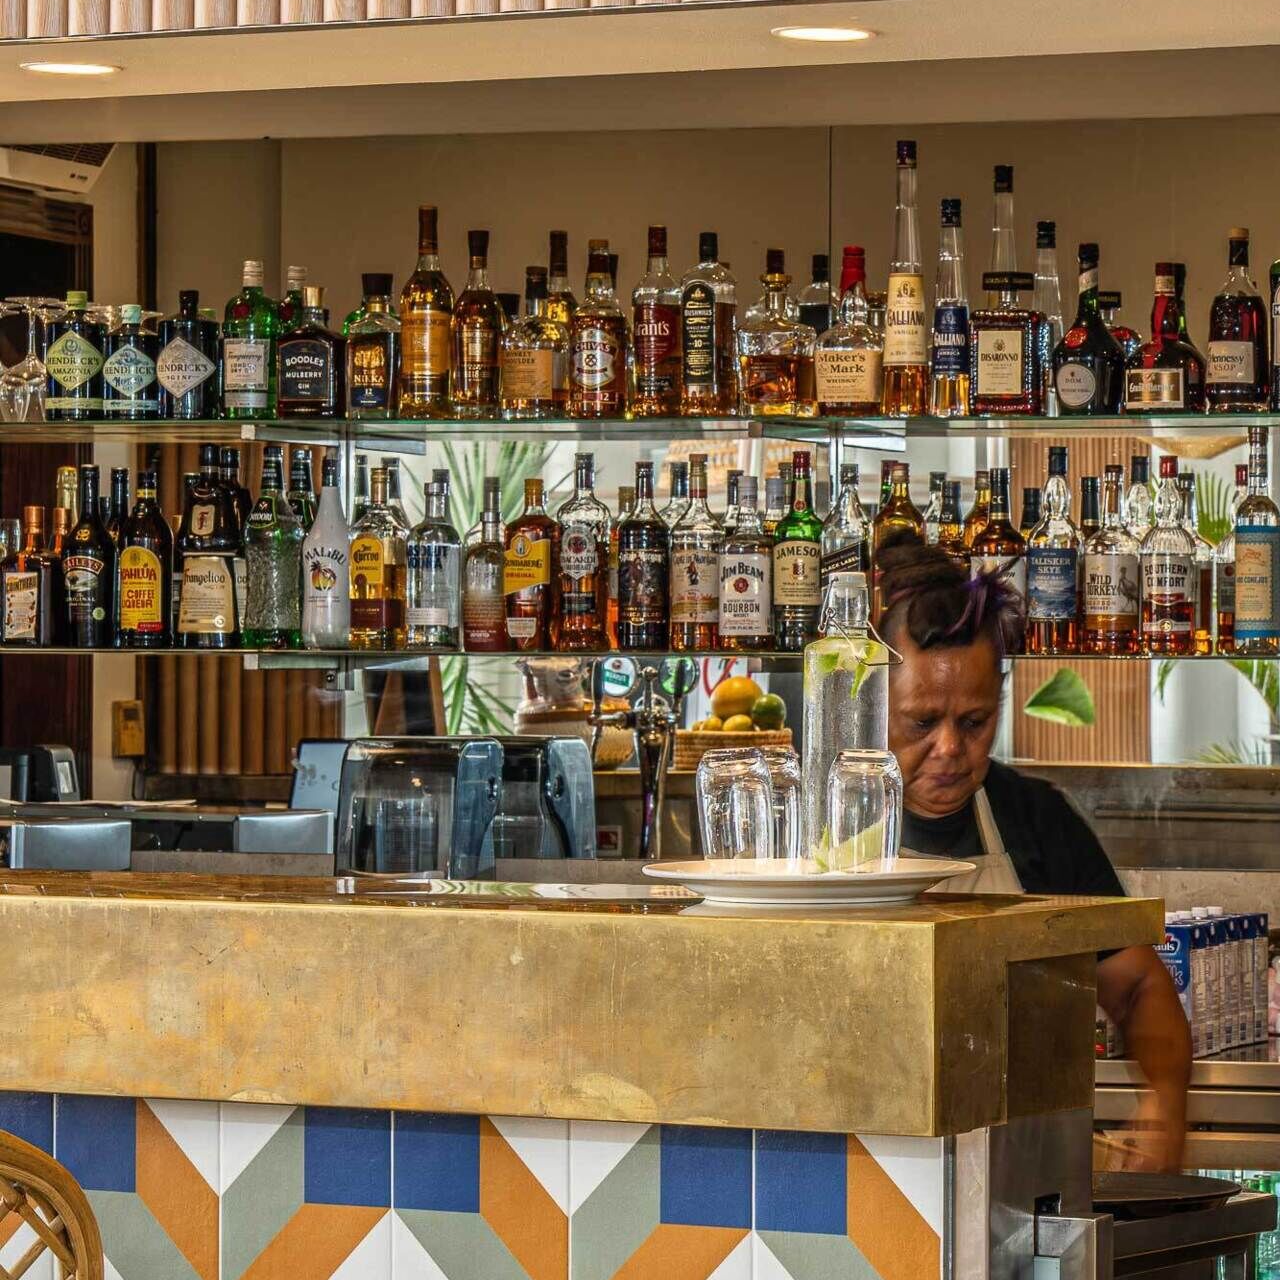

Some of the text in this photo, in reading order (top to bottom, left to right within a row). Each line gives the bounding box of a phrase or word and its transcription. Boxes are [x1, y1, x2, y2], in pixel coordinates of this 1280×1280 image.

[684, 309, 713, 317] BUSHMILLS
[575, 341, 611, 353] CHIVAS
[693, 339, 703, 348] 10
[47, 356, 99, 366] HENDRCK'S
[285, 355, 325, 367] BOODLES
[818, 352, 866, 363] Maker's
[980, 352, 1019, 361] DISARONNO
[830, 363, 866, 374] Mark
[285, 371, 323, 379] MULBERRY
[991, 495, 1004, 504] CC
[720, 562, 764, 582] JIM BEAM
[1037, 566, 1062, 574] SKYE
[1144, 564, 1188, 577] SOUTHERN
[1088, 573, 1112, 586] WILD
[1146, 577, 1186, 588] COMFORT
[126, 589, 155, 599] COFFEE
[723, 603, 760, 613] BOURBON
